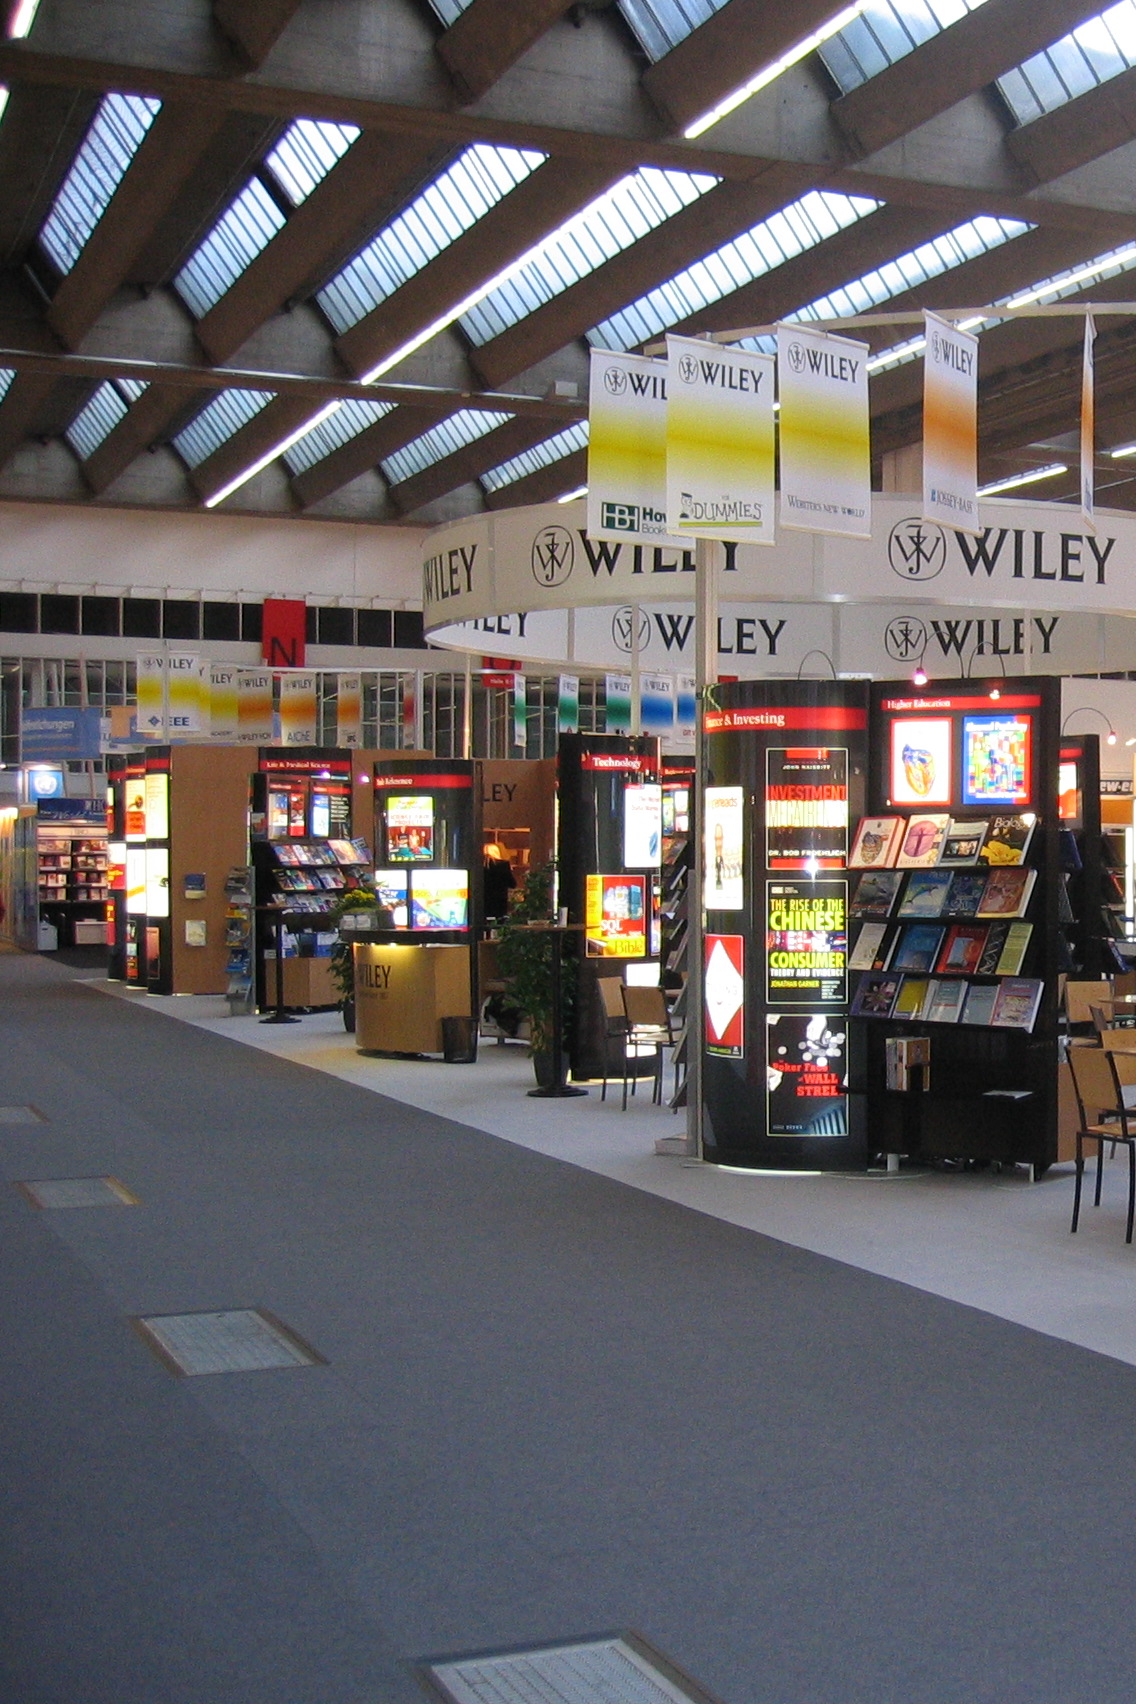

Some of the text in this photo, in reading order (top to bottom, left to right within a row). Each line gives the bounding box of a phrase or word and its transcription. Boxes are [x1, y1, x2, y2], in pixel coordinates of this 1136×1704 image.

[806, 348, 860, 384] WILEY
[942, 342, 974, 377] WILEY
[700, 359, 764, 394] WILEY
[628, 371, 668, 400] WIL
[693, 502, 763, 523] DUMMIES
[954, 527, 1118, 585] WILEY
[424, 544, 478, 605] WILEY
[653, 612, 788, 655] WLEY
[245, 677, 269, 688] WILEY
[649, 680, 671, 692] WILEY
[887, 698, 951, 710] Higher Education
[733, 712, 786, 727] Investing
[592, 757, 642, 769] Technology
[770, 898, 844, 911] THE RISE OF THE
[601, 920, 622, 931] SQL
[770, 910, 844, 931] CHINESE
[615, 940, 643, 953] Bible
[770, 951, 845, 968] CONSUMER
[770, 968, 795, 977] THEORY
[796, 968, 810, 977] AND
[771, 1062, 802, 1073] Poker
[804, 1074, 838, 1084] WALL
